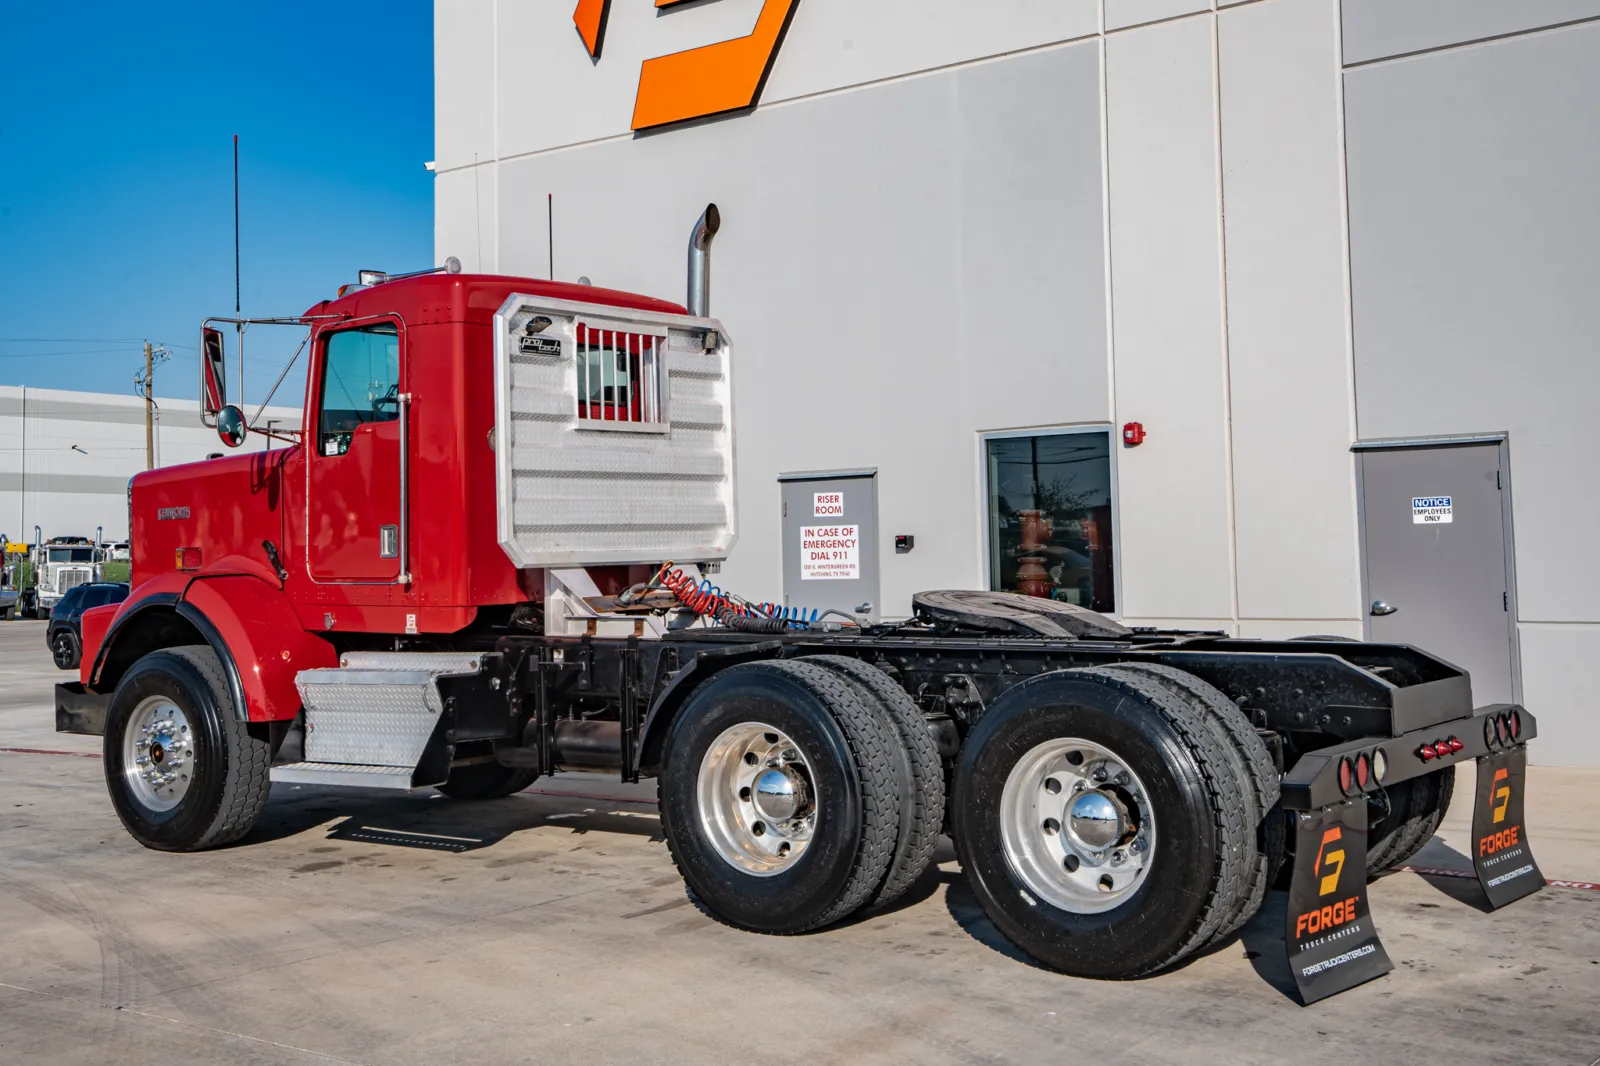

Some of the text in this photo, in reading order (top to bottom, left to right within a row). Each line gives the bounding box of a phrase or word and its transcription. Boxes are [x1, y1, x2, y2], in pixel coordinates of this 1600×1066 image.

[817, 495, 840, 504] RISER
[1414, 498, 1449, 507] NOTICE
[157, 506, 191, 520] KENWORTH
[815, 506, 842, 514] ROOM
[804, 527, 854, 537] IN CASE OF
[803, 539, 856, 549] EMERGENCY
[810, 551, 848, 561] DIAL 911
[1480, 826, 1519, 857] FORGE
[1296, 897, 1357, 938] FORGE
[1300, 925, 1360, 951] TRUCK CENTERS
[1302, 944, 1376, 977] FORGETRUCKCENTERS.COM
